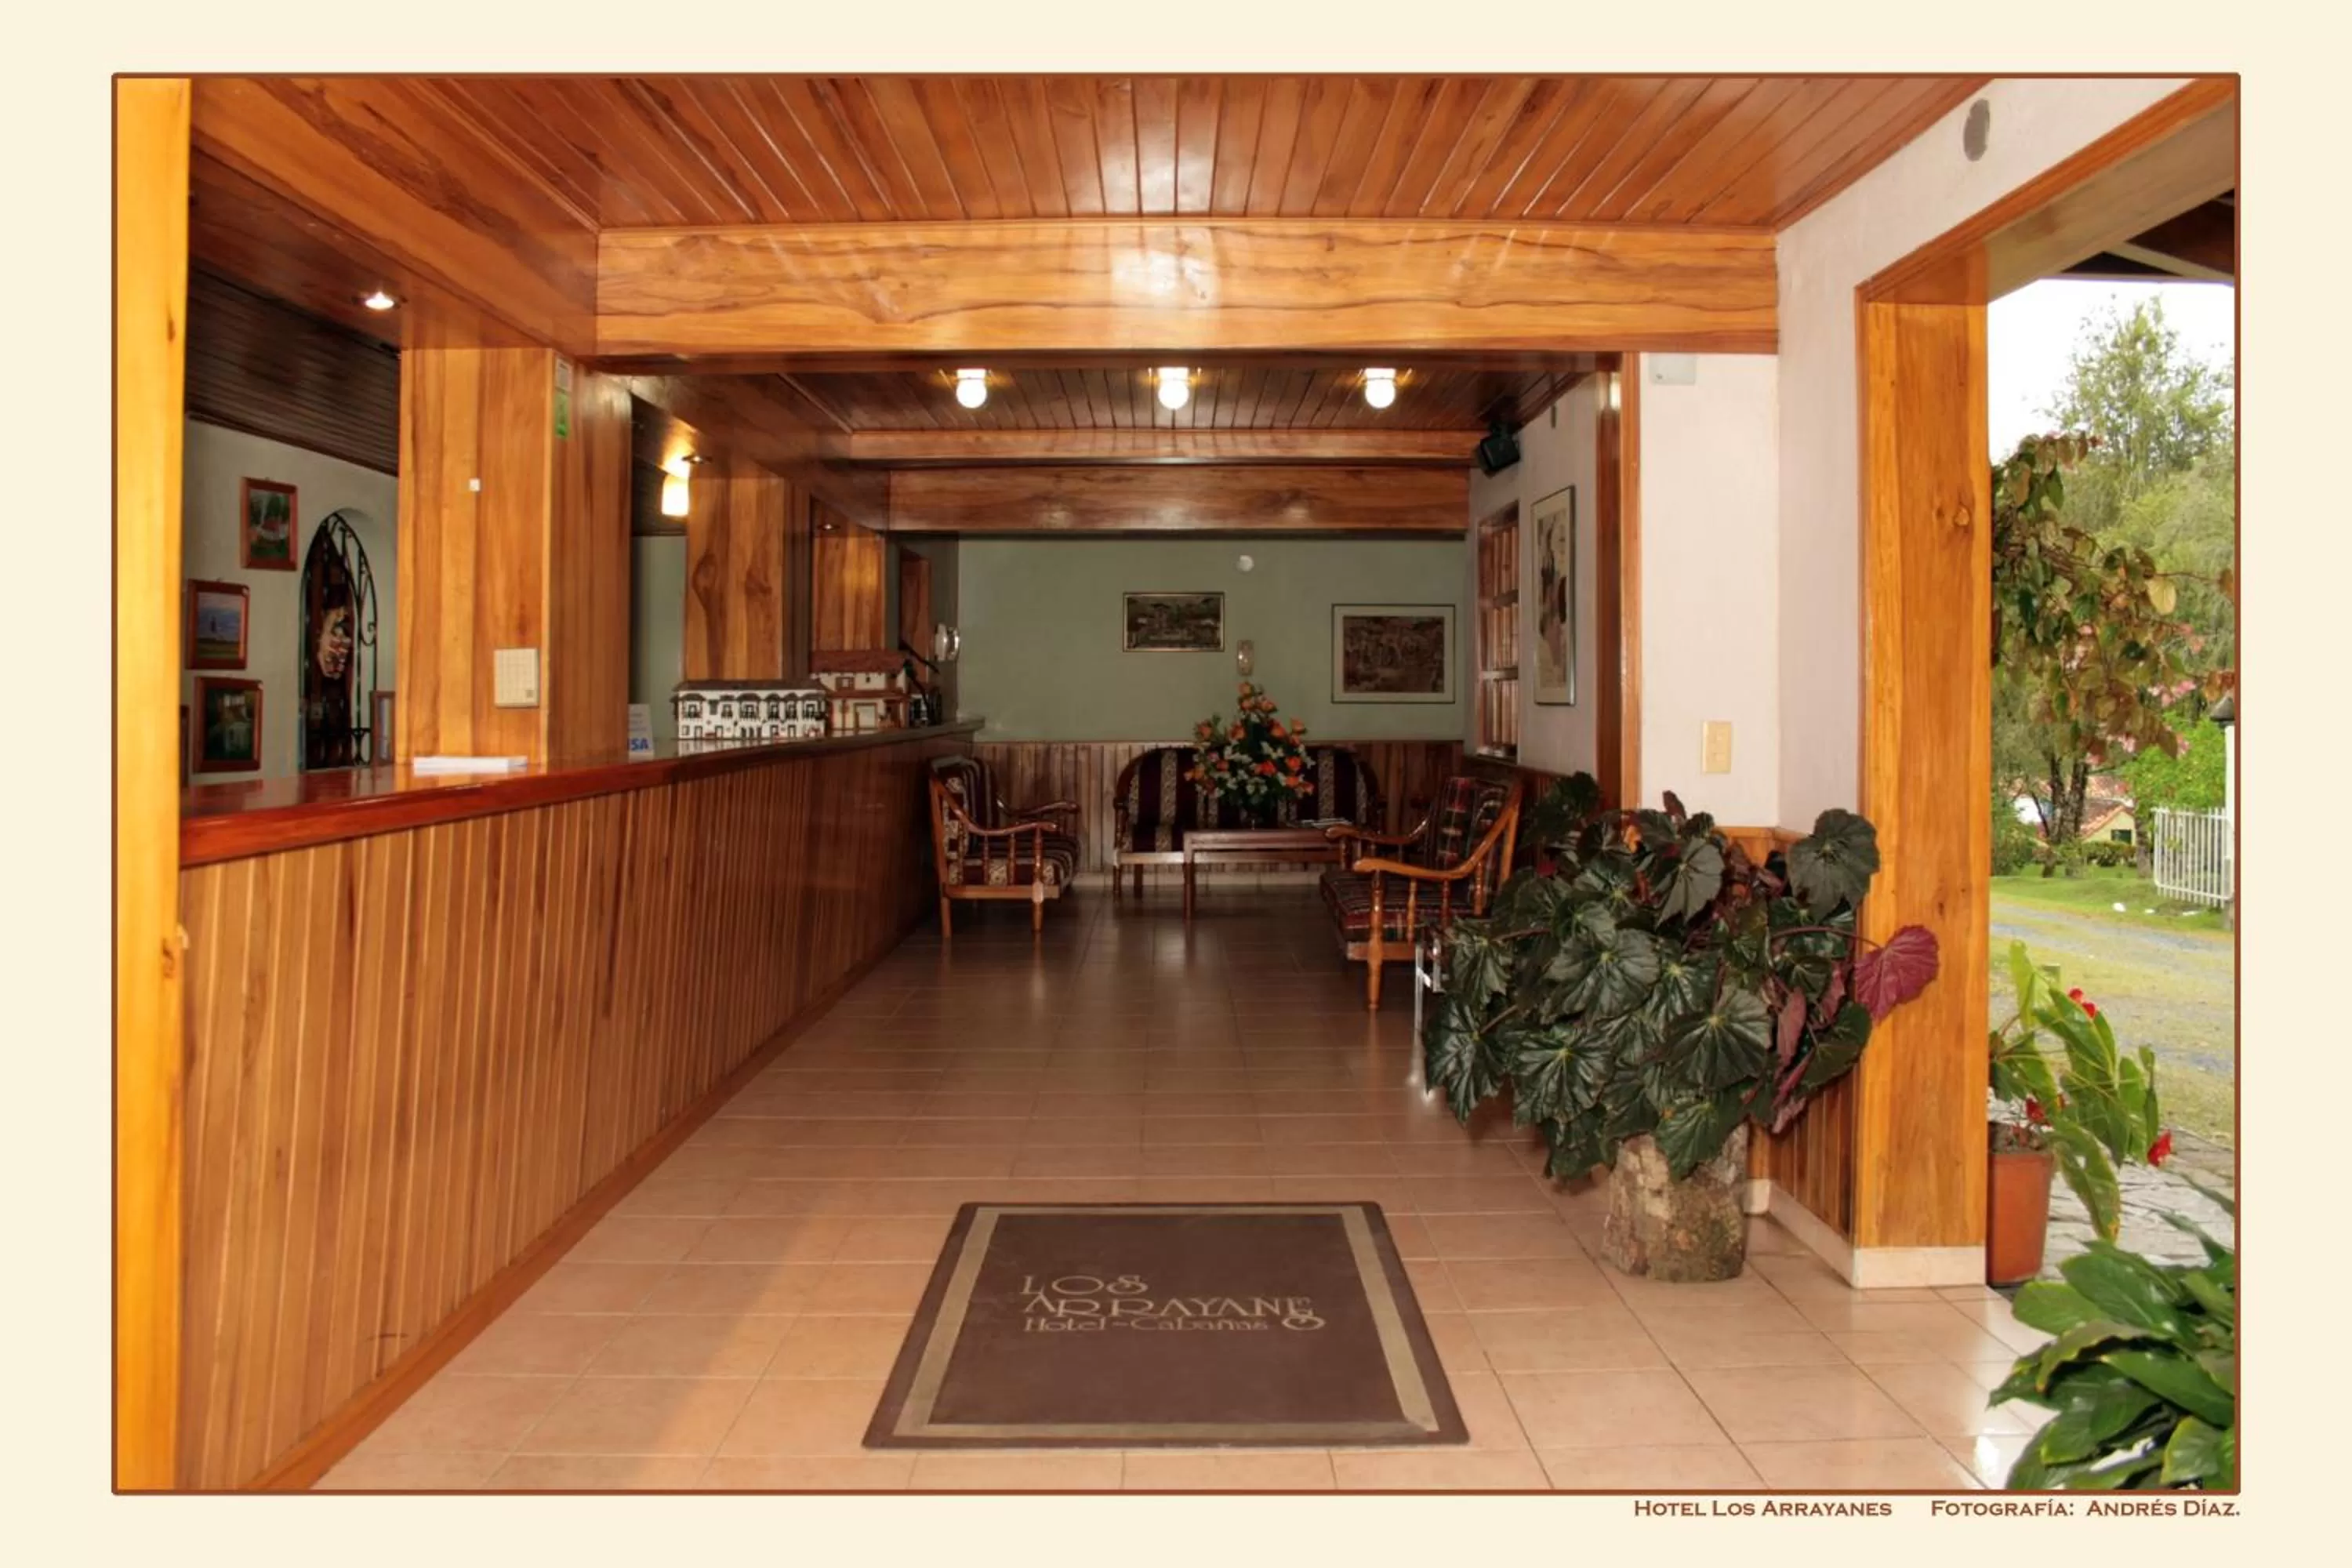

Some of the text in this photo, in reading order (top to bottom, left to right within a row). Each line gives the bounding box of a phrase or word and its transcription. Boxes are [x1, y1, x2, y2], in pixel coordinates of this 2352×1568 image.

[628, 738, 649, 751] SA
[1021, 1275, 1149, 1295] LOS
[1022, 1293, 1327, 1330] ARRAYANES
